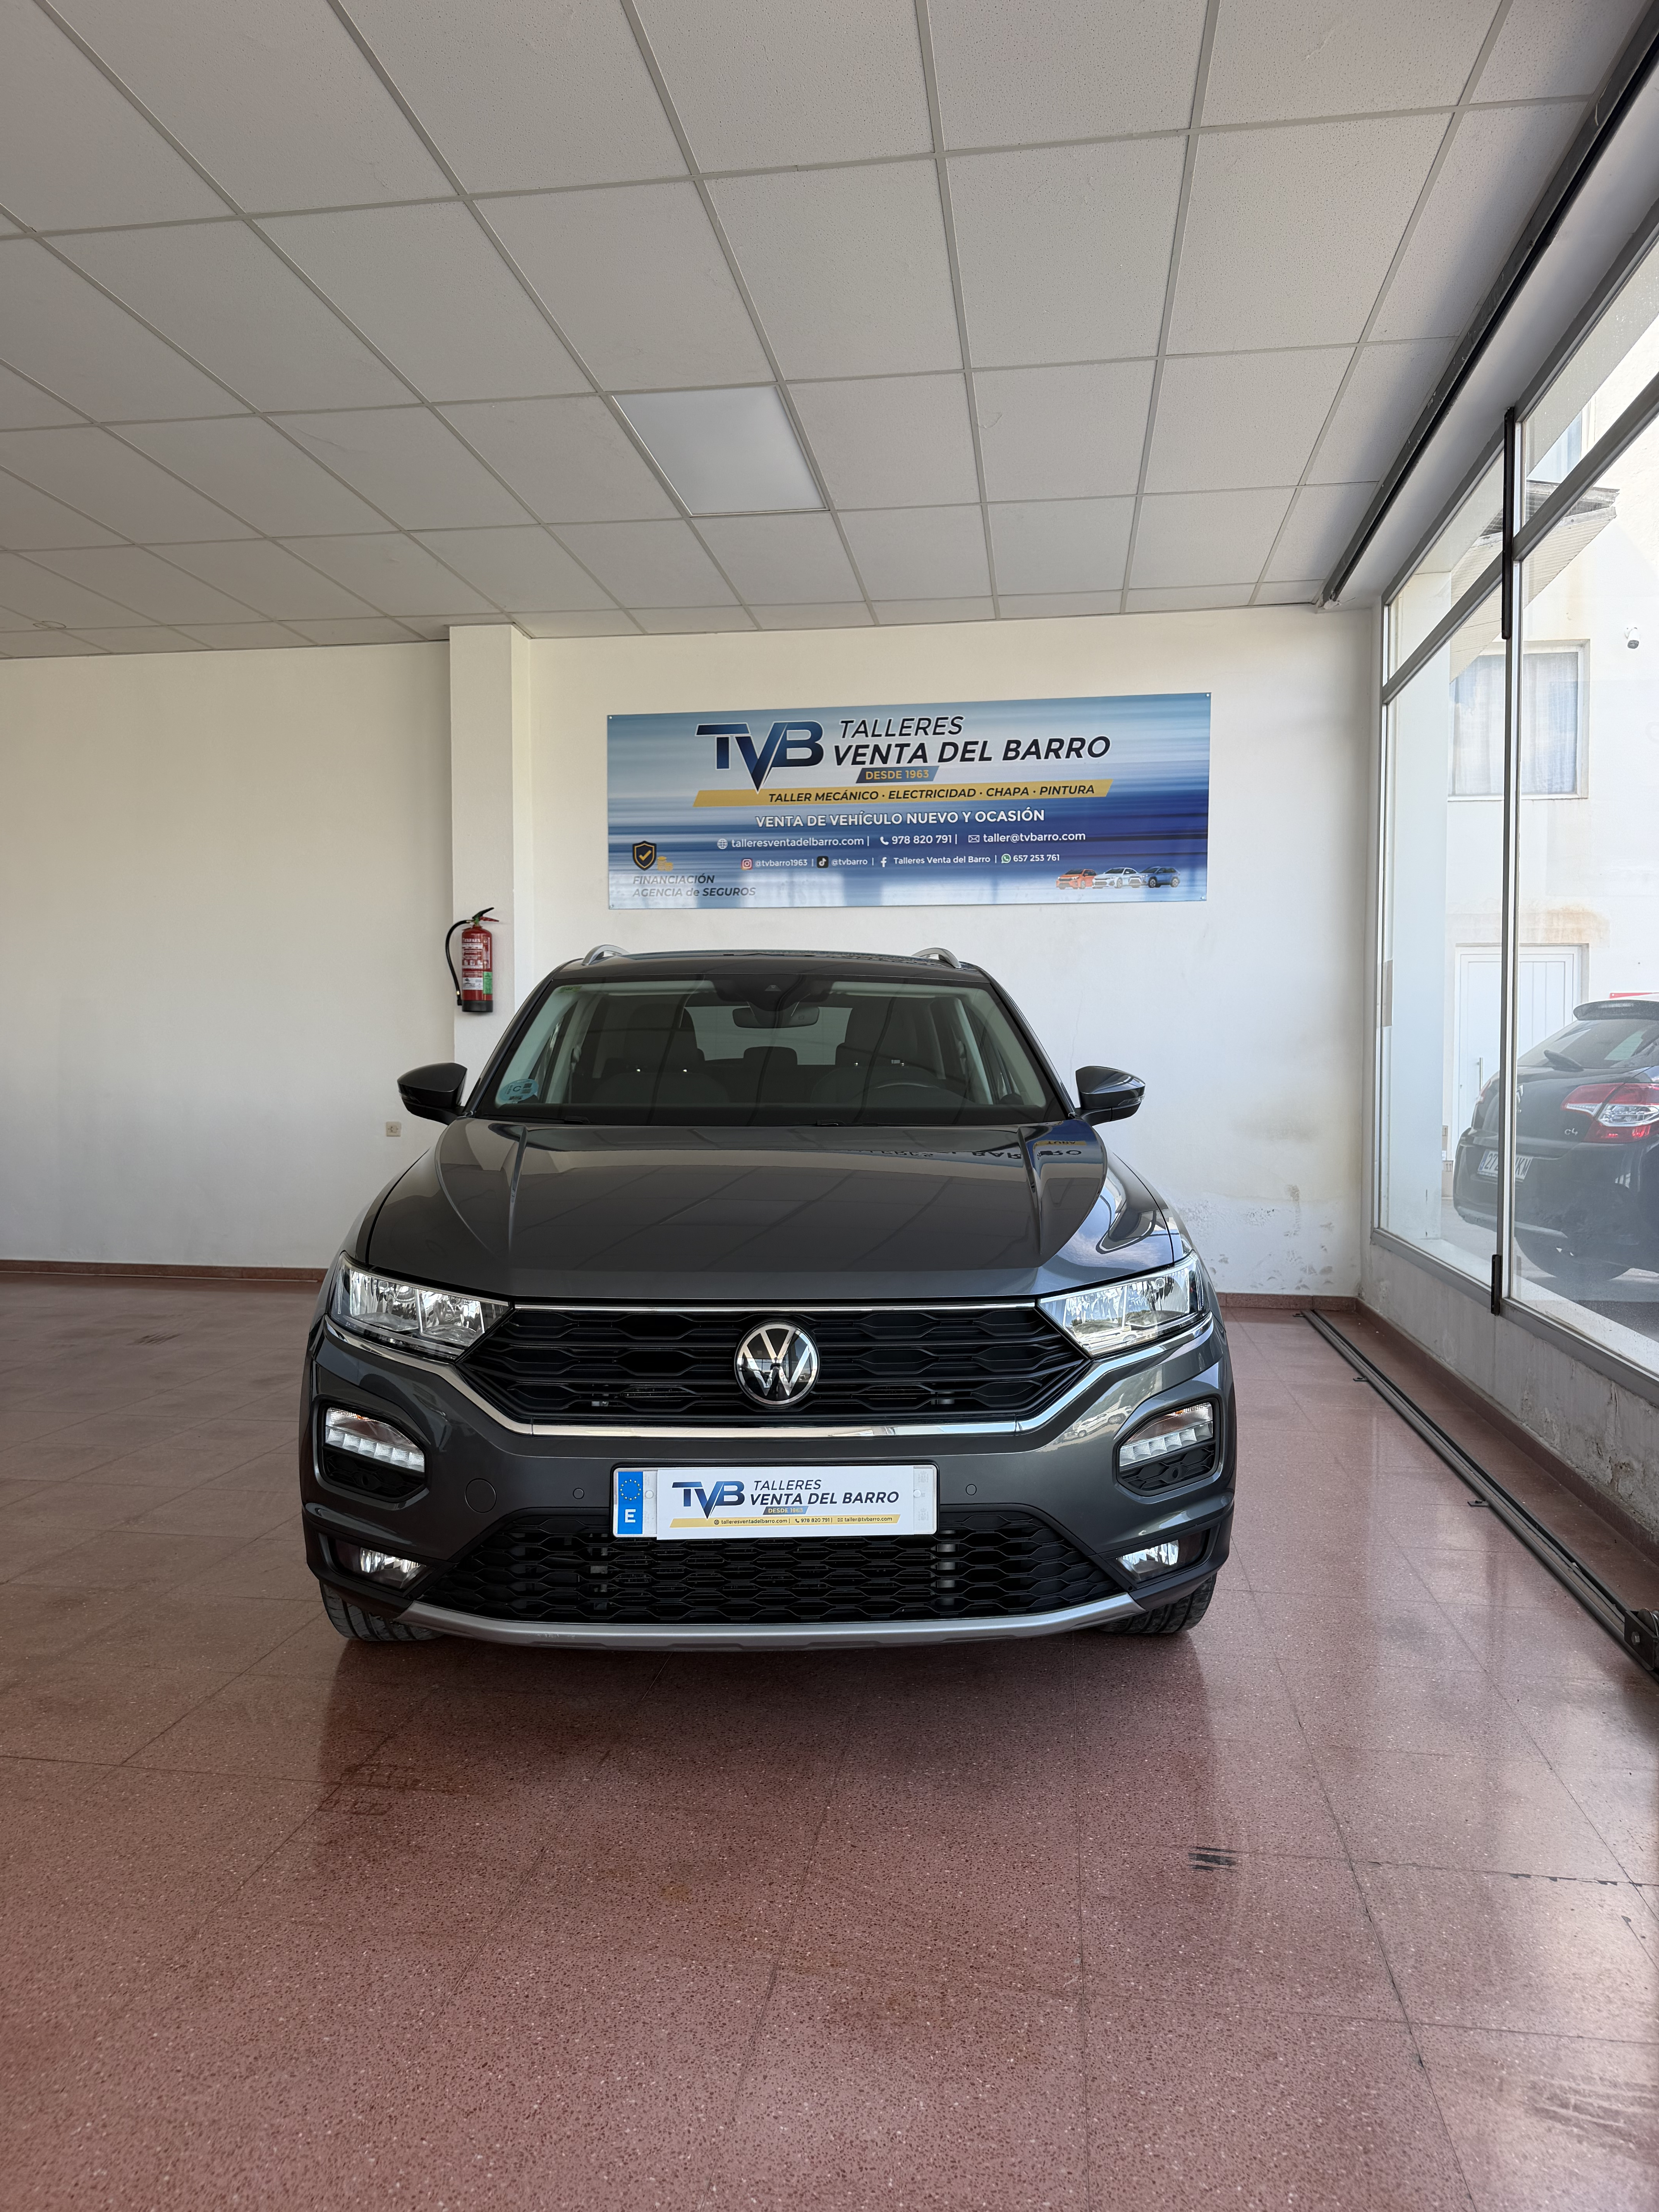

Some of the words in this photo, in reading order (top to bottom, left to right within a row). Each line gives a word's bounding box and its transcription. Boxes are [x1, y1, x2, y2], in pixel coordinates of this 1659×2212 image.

[841, 716, 964, 738] TALLERES
[696, 721, 824, 793] TVB
[835, 743, 928, 766] VENTA
[938, 741, 992, 763] DEL
[1002, 736, 1110, 761] BARRO
[866, 770, 902, 780] DESDE
[905, 769, 929, 778] 1963
[769, 793, 811, 802] TALLER
[815, 790, 879, 802] MECÁNICO
[888, 788, 976, 799] ELECTRICIDAD
[986, 787, 1029, 797] CHAPA
[1039, 785, 1094, 795] PINTURA
[756, 816, 804, 827] VENTA
[807, 815, 826, 826] DE
[830, 810, 903, 826] VEHÍCULO
[907, 812, 958, 824] NUEVO
[962, 812, 970, 823] Y
[975, 807, 1044, 823] OCASIÓN
[732, 837, 864, 847] talleresventadelbarro.com
[891, 836, 910, 844] 978
[913, 835, 933, 844] 820
[936, 835, 952, 843] 791
[983, 833, 1085, 843] taller@tvbarro.com
[755, 859, 807, 868] @tvbarro1963
[831, 858, 868, 866] @tvbarro
[633, 873, 715, 884] FINANCIACIÓN
[632, 888, 682, 897] AGENCIA
[686, 888, 699, 896] de
[702, 887, 756, 896] SEGUROS
[754, 1479, 821, 1491] TALLERES
[672, 1480, 745, 1520] TVB
[750, 1493, 802, 1505] VENTA
[807, 1492, 837, 1504] DEL
[842, 1491, 899, 1504] BARRO
[624, 1509, 636, 1523] E
